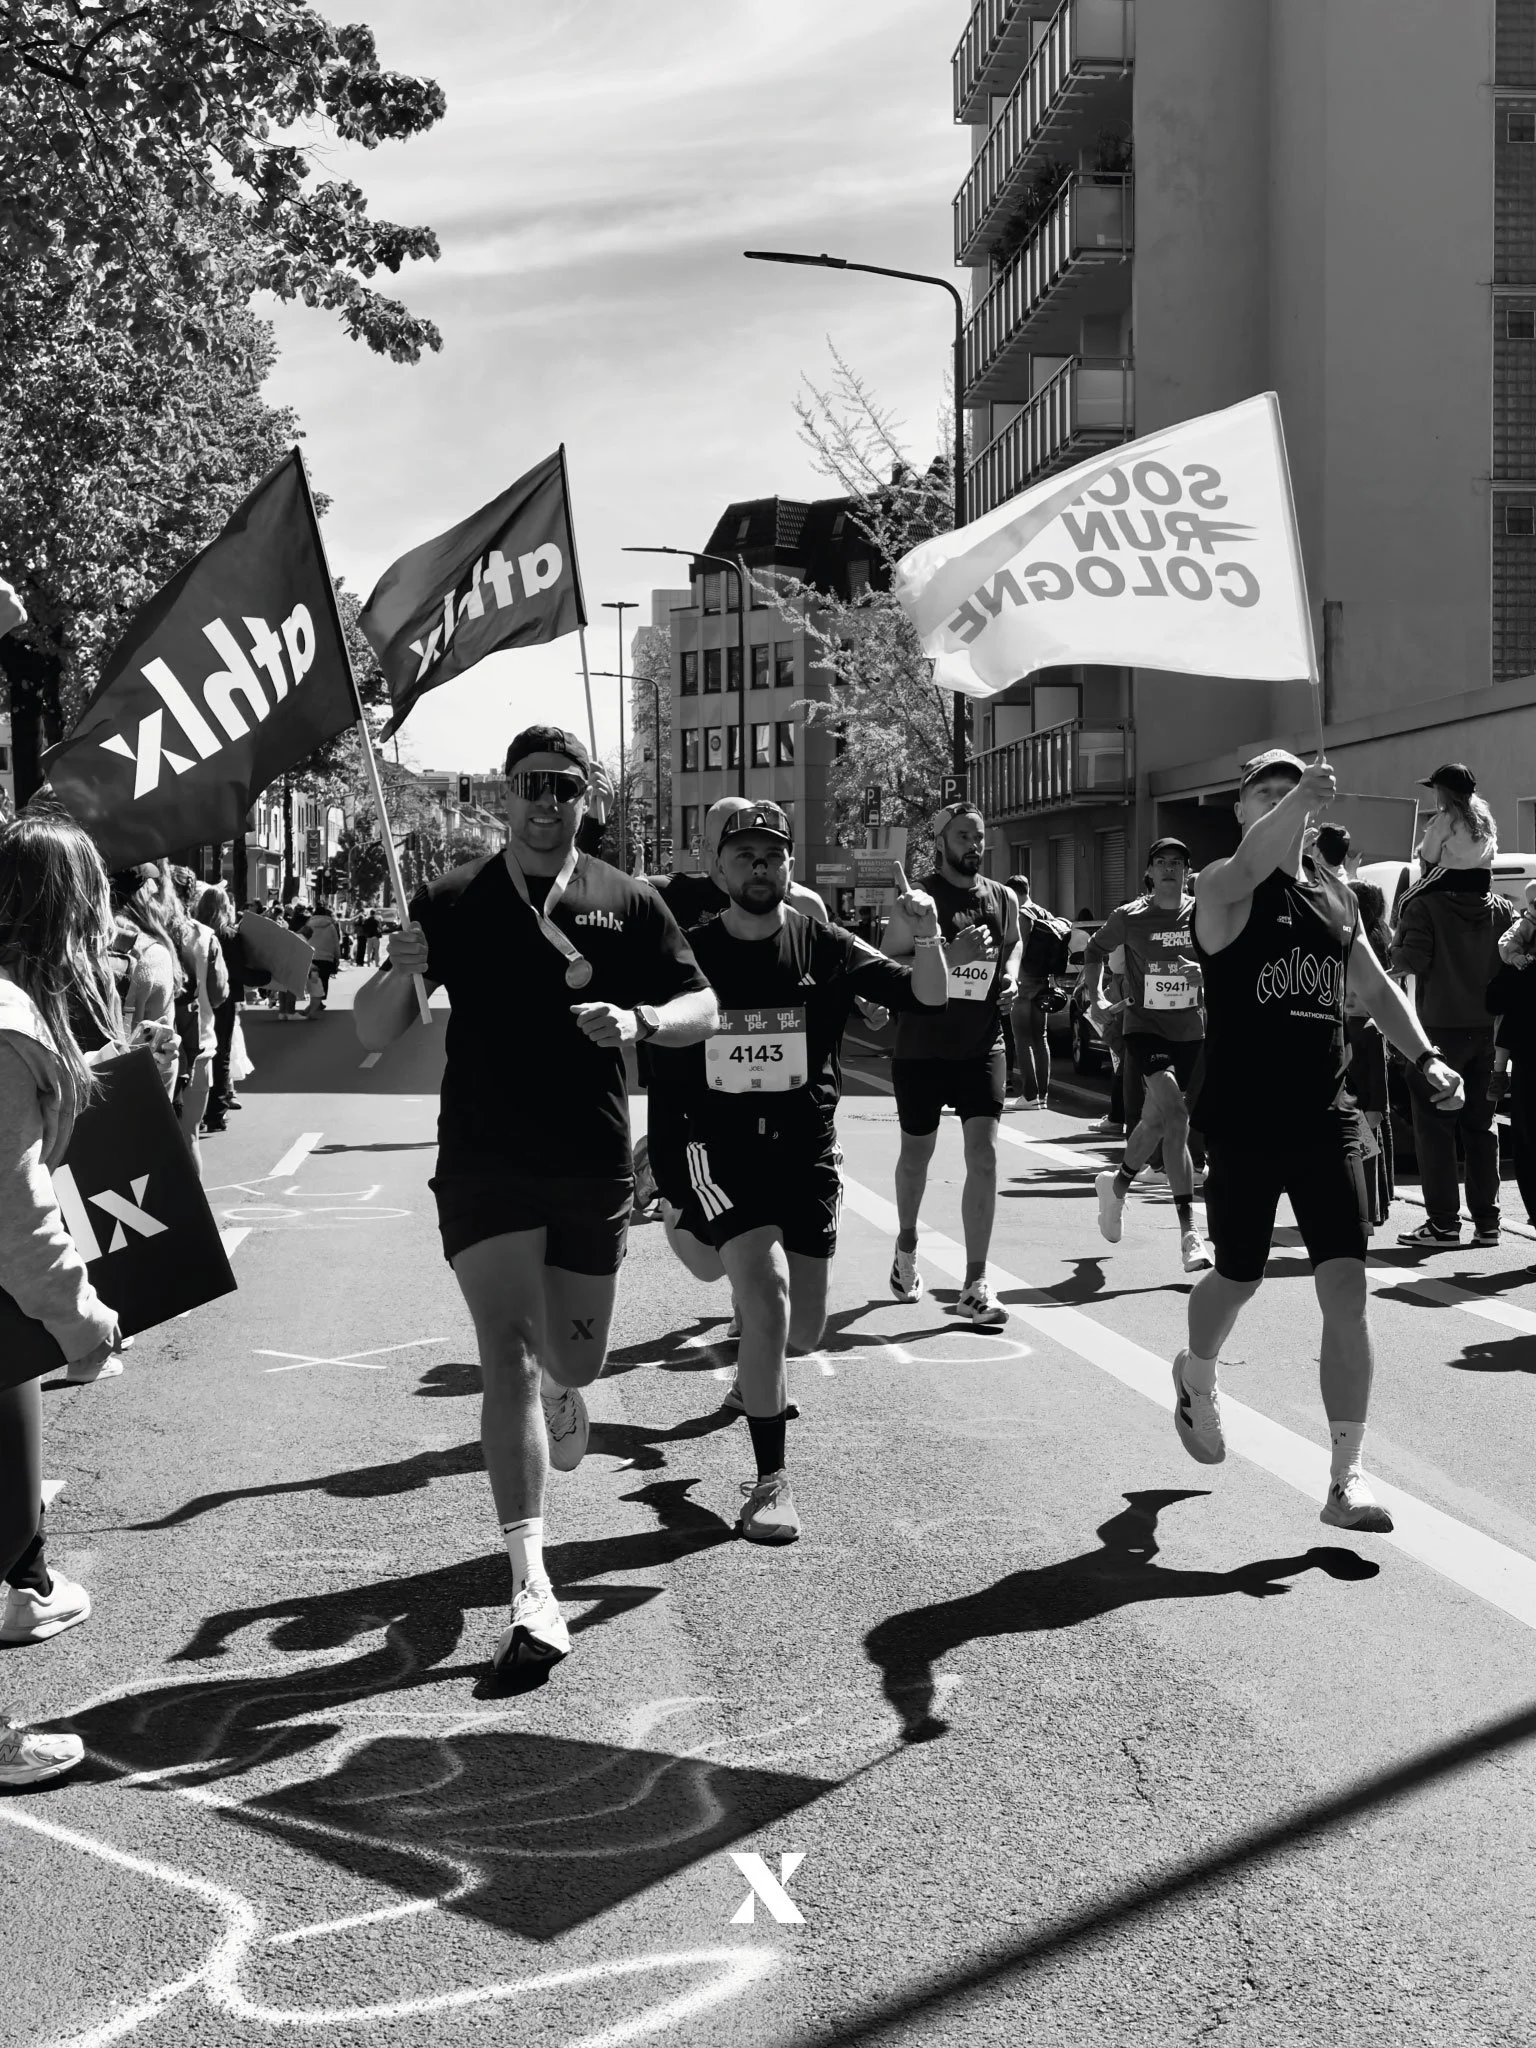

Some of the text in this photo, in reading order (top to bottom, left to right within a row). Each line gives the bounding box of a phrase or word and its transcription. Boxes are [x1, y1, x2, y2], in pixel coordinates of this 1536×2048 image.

[945, 779, 957, 799] P
[868, 789, 875, 805] P
[575, 909, 624, 932] athlx
[1151, 930, 1191, 941] AUSDAUE
[952, 966, 988, 980] 4406
[744, 1011, 761, 1022] uni
[777, 1009, 794, 1020] uni
[748, 1021, 768, 1032] per
[781, 1019, 801, 1030] per
[729, 1044, 784, 1063] 4143
